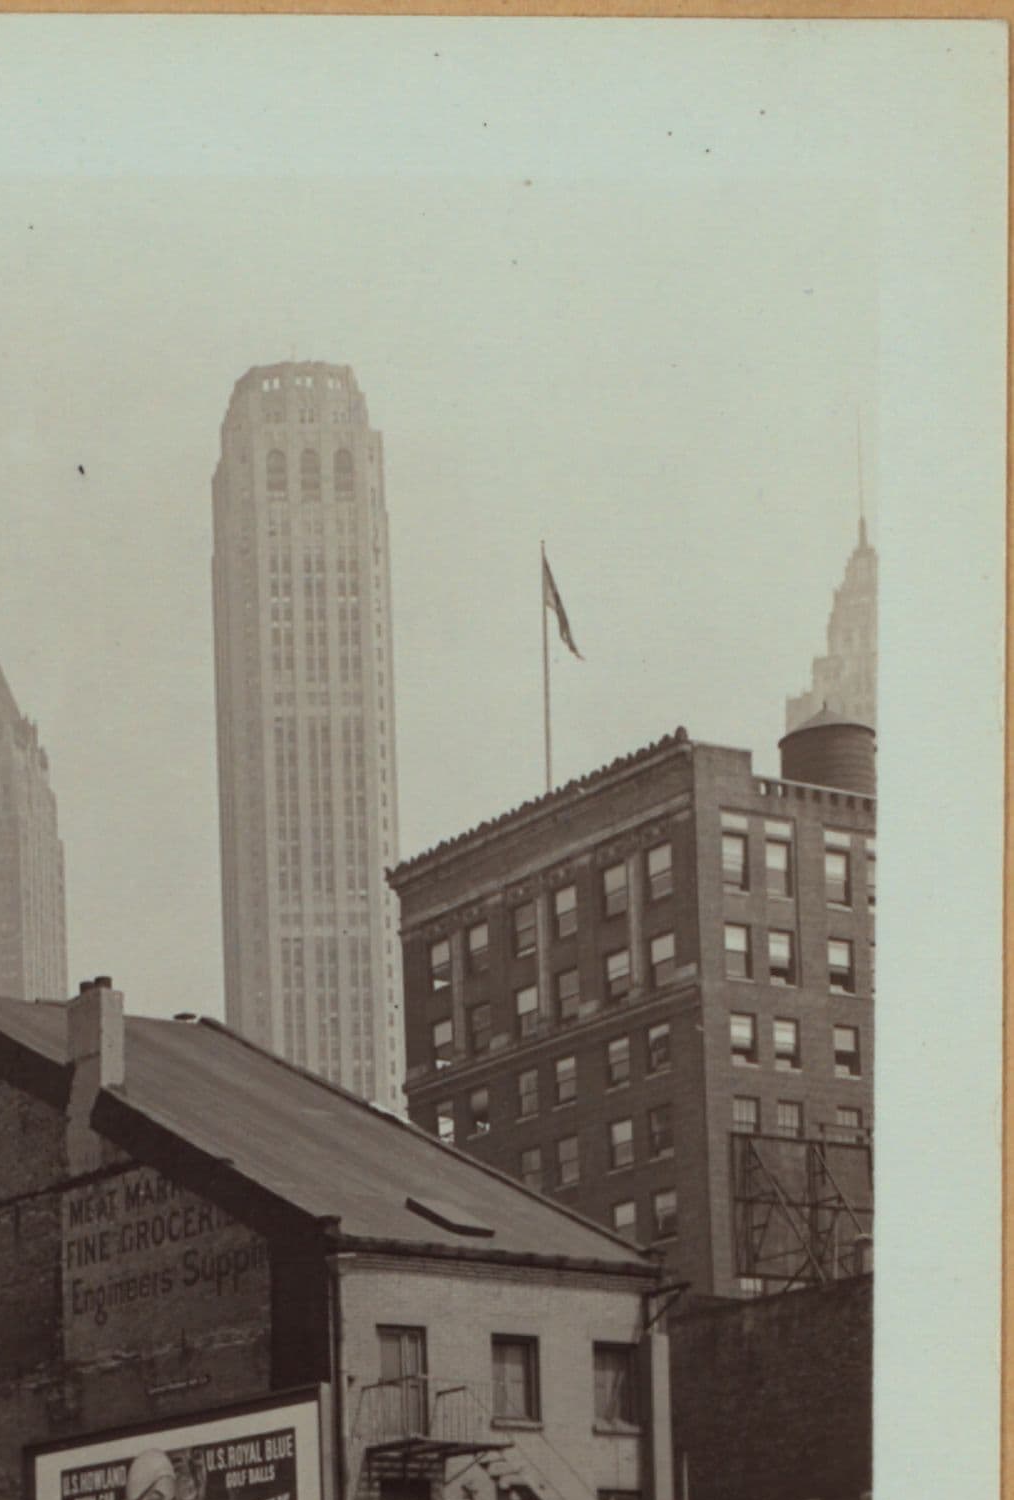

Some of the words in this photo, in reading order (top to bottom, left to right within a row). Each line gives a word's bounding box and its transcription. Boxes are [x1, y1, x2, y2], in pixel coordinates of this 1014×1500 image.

[69, 1190, 117, 1227] MEAT
[66, 1230, 111, 1270] FINE
[228, 1440, 262, 1468] ROYAL
[265, 1434, 293, 1461] BLUE
[226, 1469, 247, 1489] GOLF
[249, 1464, 276, 1485] BALLS
